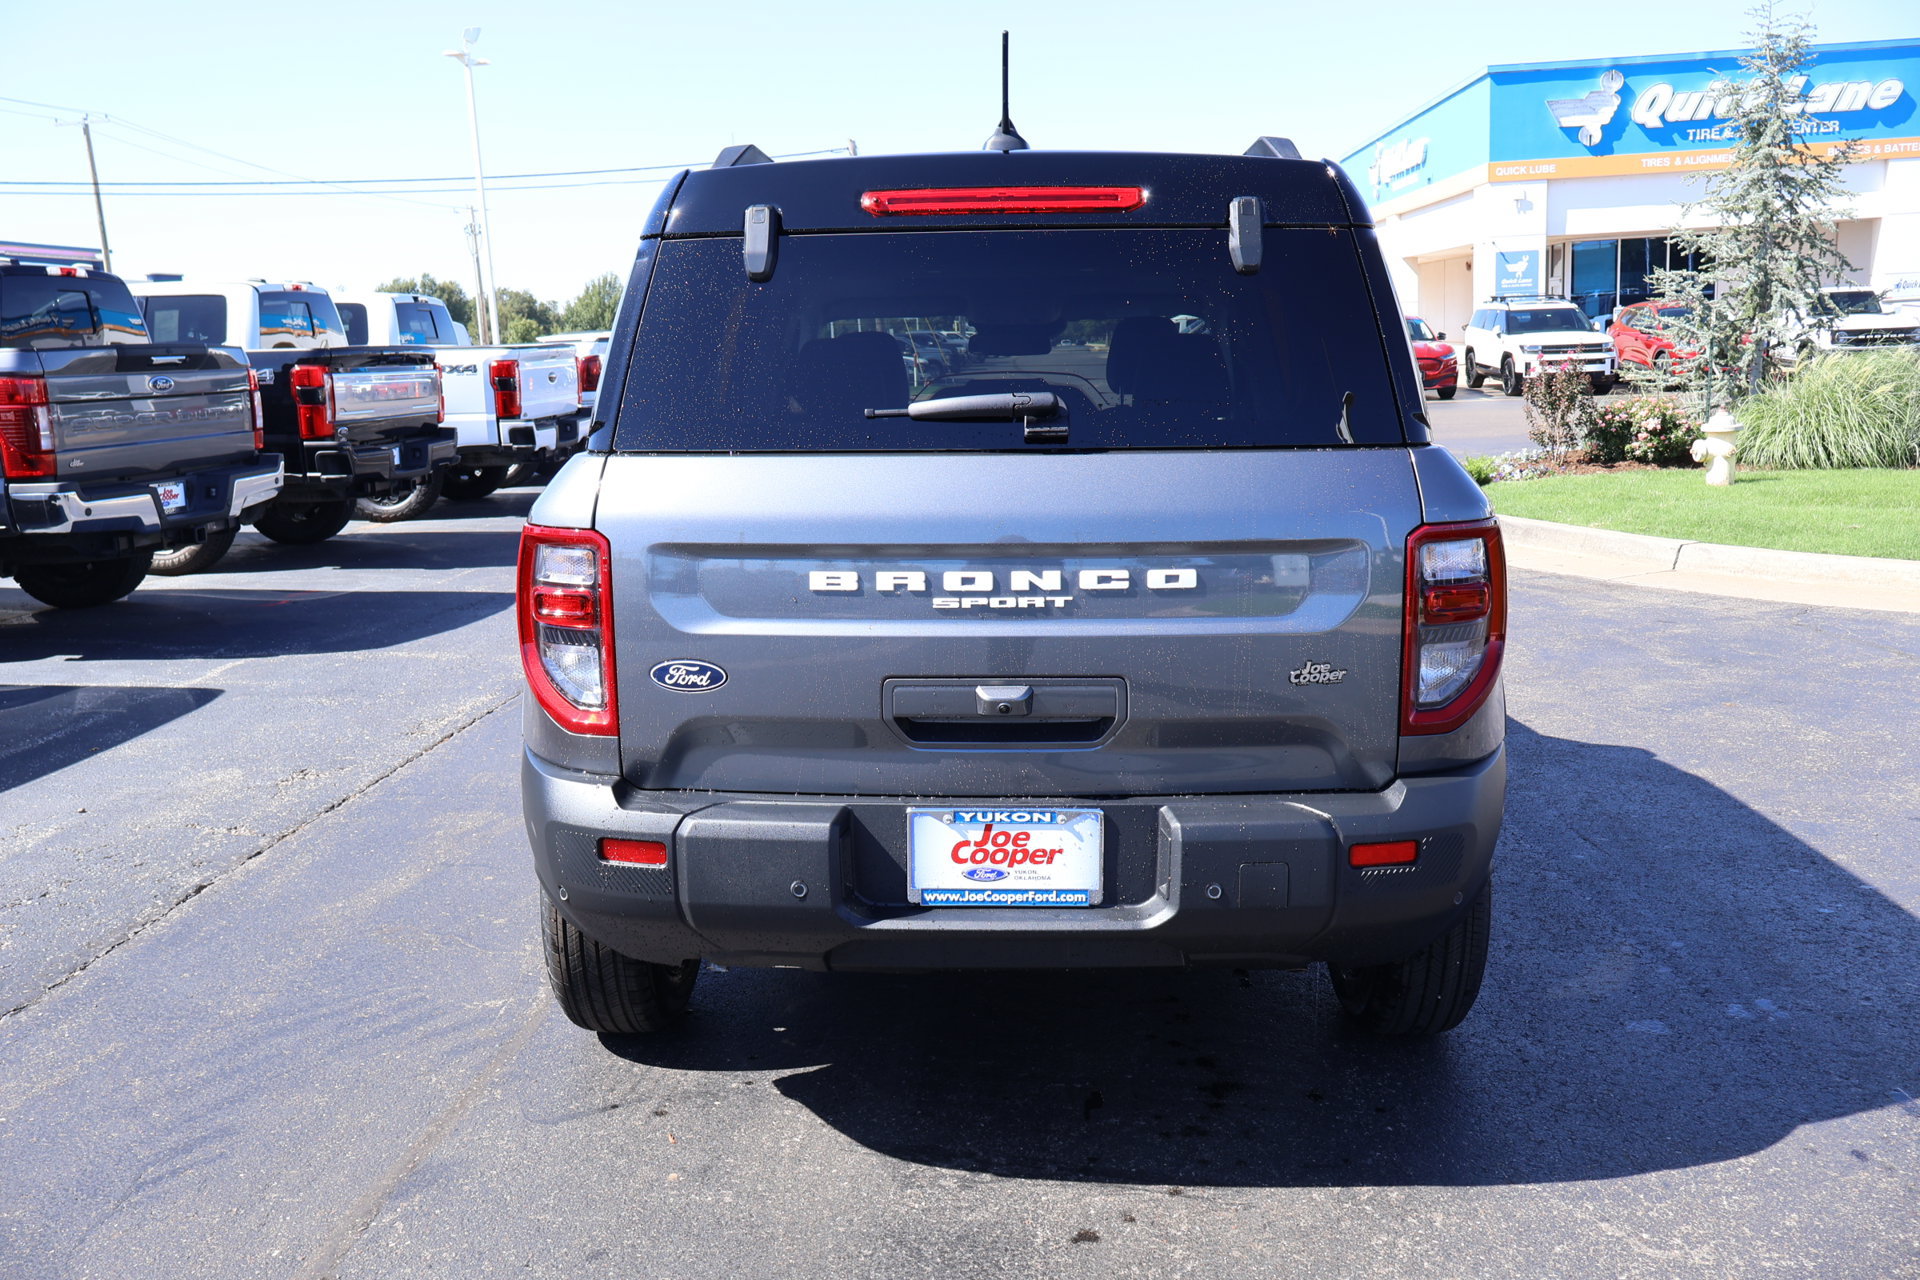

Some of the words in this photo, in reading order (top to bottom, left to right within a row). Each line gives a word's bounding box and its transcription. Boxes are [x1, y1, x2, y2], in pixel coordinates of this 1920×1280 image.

[1687, 126, 1721, 141] TIRE
[1722, 126, 1737, 140] &
[1786, 119, 1840, 136] ENTER
[1873, 144, 1882, 154] &
[1884, 141, 1920, 153] BATTE
[1641, 156, 1670, 168] TIRES
[1674, 156, 1682, 166] &
[1683, 153, 1737, 166] ALIGNMEN
[1495, 166, 1526, 176] QUICK
[1529, 164, 1556, 174] LUBE
[808, 568, 1198, 592] BRONCO
[932, 596, 1073, 609] SPORT
[1301, 661, 1331, 674] Joe
[665, 664, 711, 686] Ford
[1290, 669, 1347, 683] Cooper
[959, 812, 1051, 823] YUKON
[973, 824, 1031, 848] Joe
[951, 840, 1064, 868] Cooper
[973, 868, 998, 881] Ford
[923, 891, 1087, 905] www.JoeCooperFord.com
